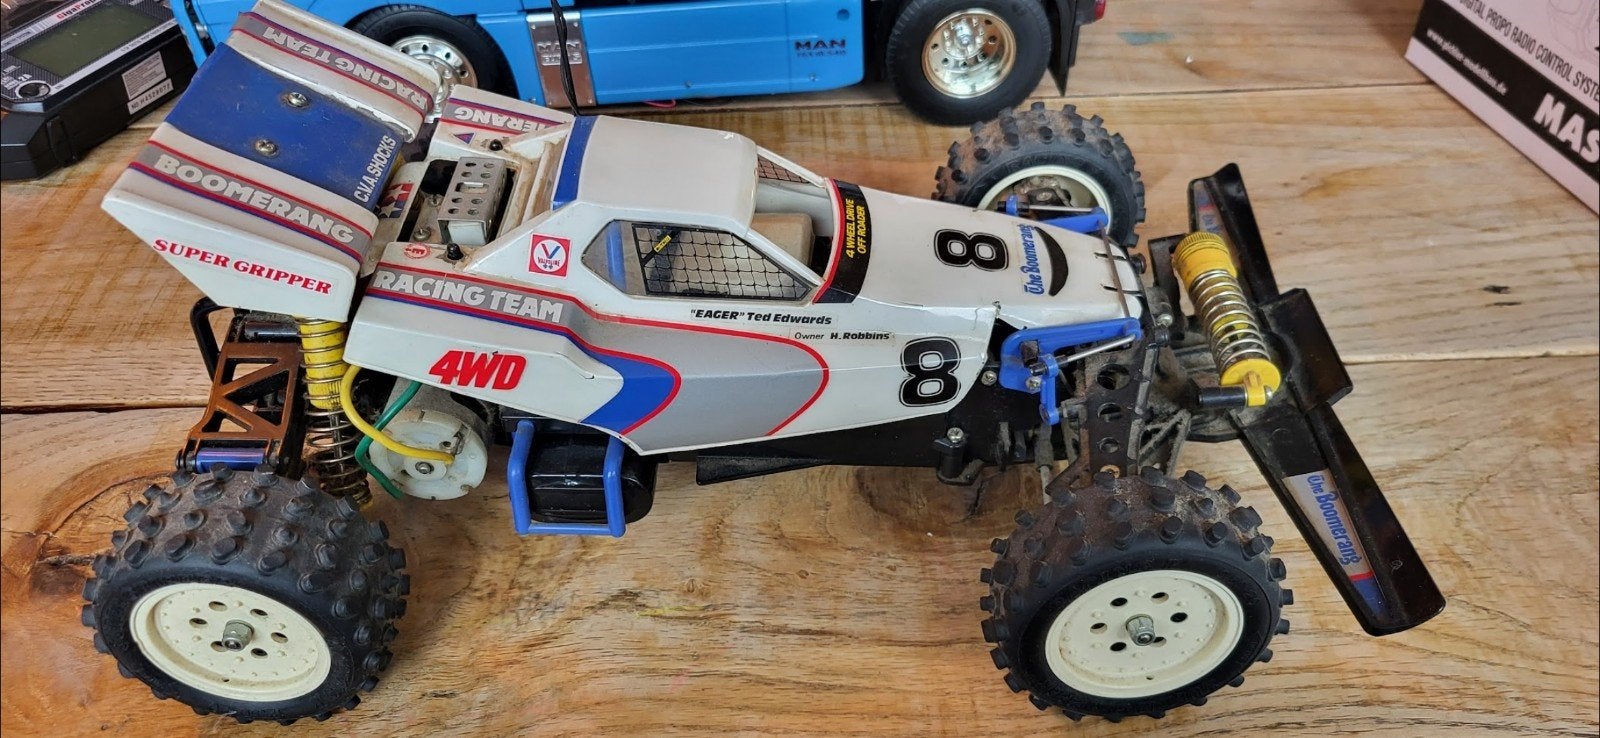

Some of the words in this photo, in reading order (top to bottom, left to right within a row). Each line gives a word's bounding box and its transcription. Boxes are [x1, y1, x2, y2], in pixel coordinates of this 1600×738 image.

[263, 26, 332, 68] TEAM
[795, 38, 847, 50] MAN
[1485, 8, 1512, 37] PROPO
[1510, 26, 1537, 54] RADIO
[1535, 44, 1572, 83] CONTROL
[335, 57, 428, 111] RACING
[153, 154, 354, 244] BOOMERANG
[845, 198, 855, 221] DRIVE
[846, 222, 855, 249] WHEEL
[856, 205, 867, 237] ROADER
[845, 249, 855, 259] 4
[856, 236, 867, 254] OFF
[933, 228, 1009, 272] 8
[1017, 224, 1041, 274] Boomerang
[153, 238, 231, 269] SUPER
[233, 259, 333, 296] GRIPPER
[372, 270, 486, 306] RACING
[489, 289, 564, 324] TEAM
[747, 312, 772, 322] Ted
[773, 314, 833, 325] Edwards
[794, 332, 825, 341] Owner
[428, 350, 528, 391] 4WD
[899, 336, 961, 408] 8
[1315, 490, 1362, 566] Boomerang
